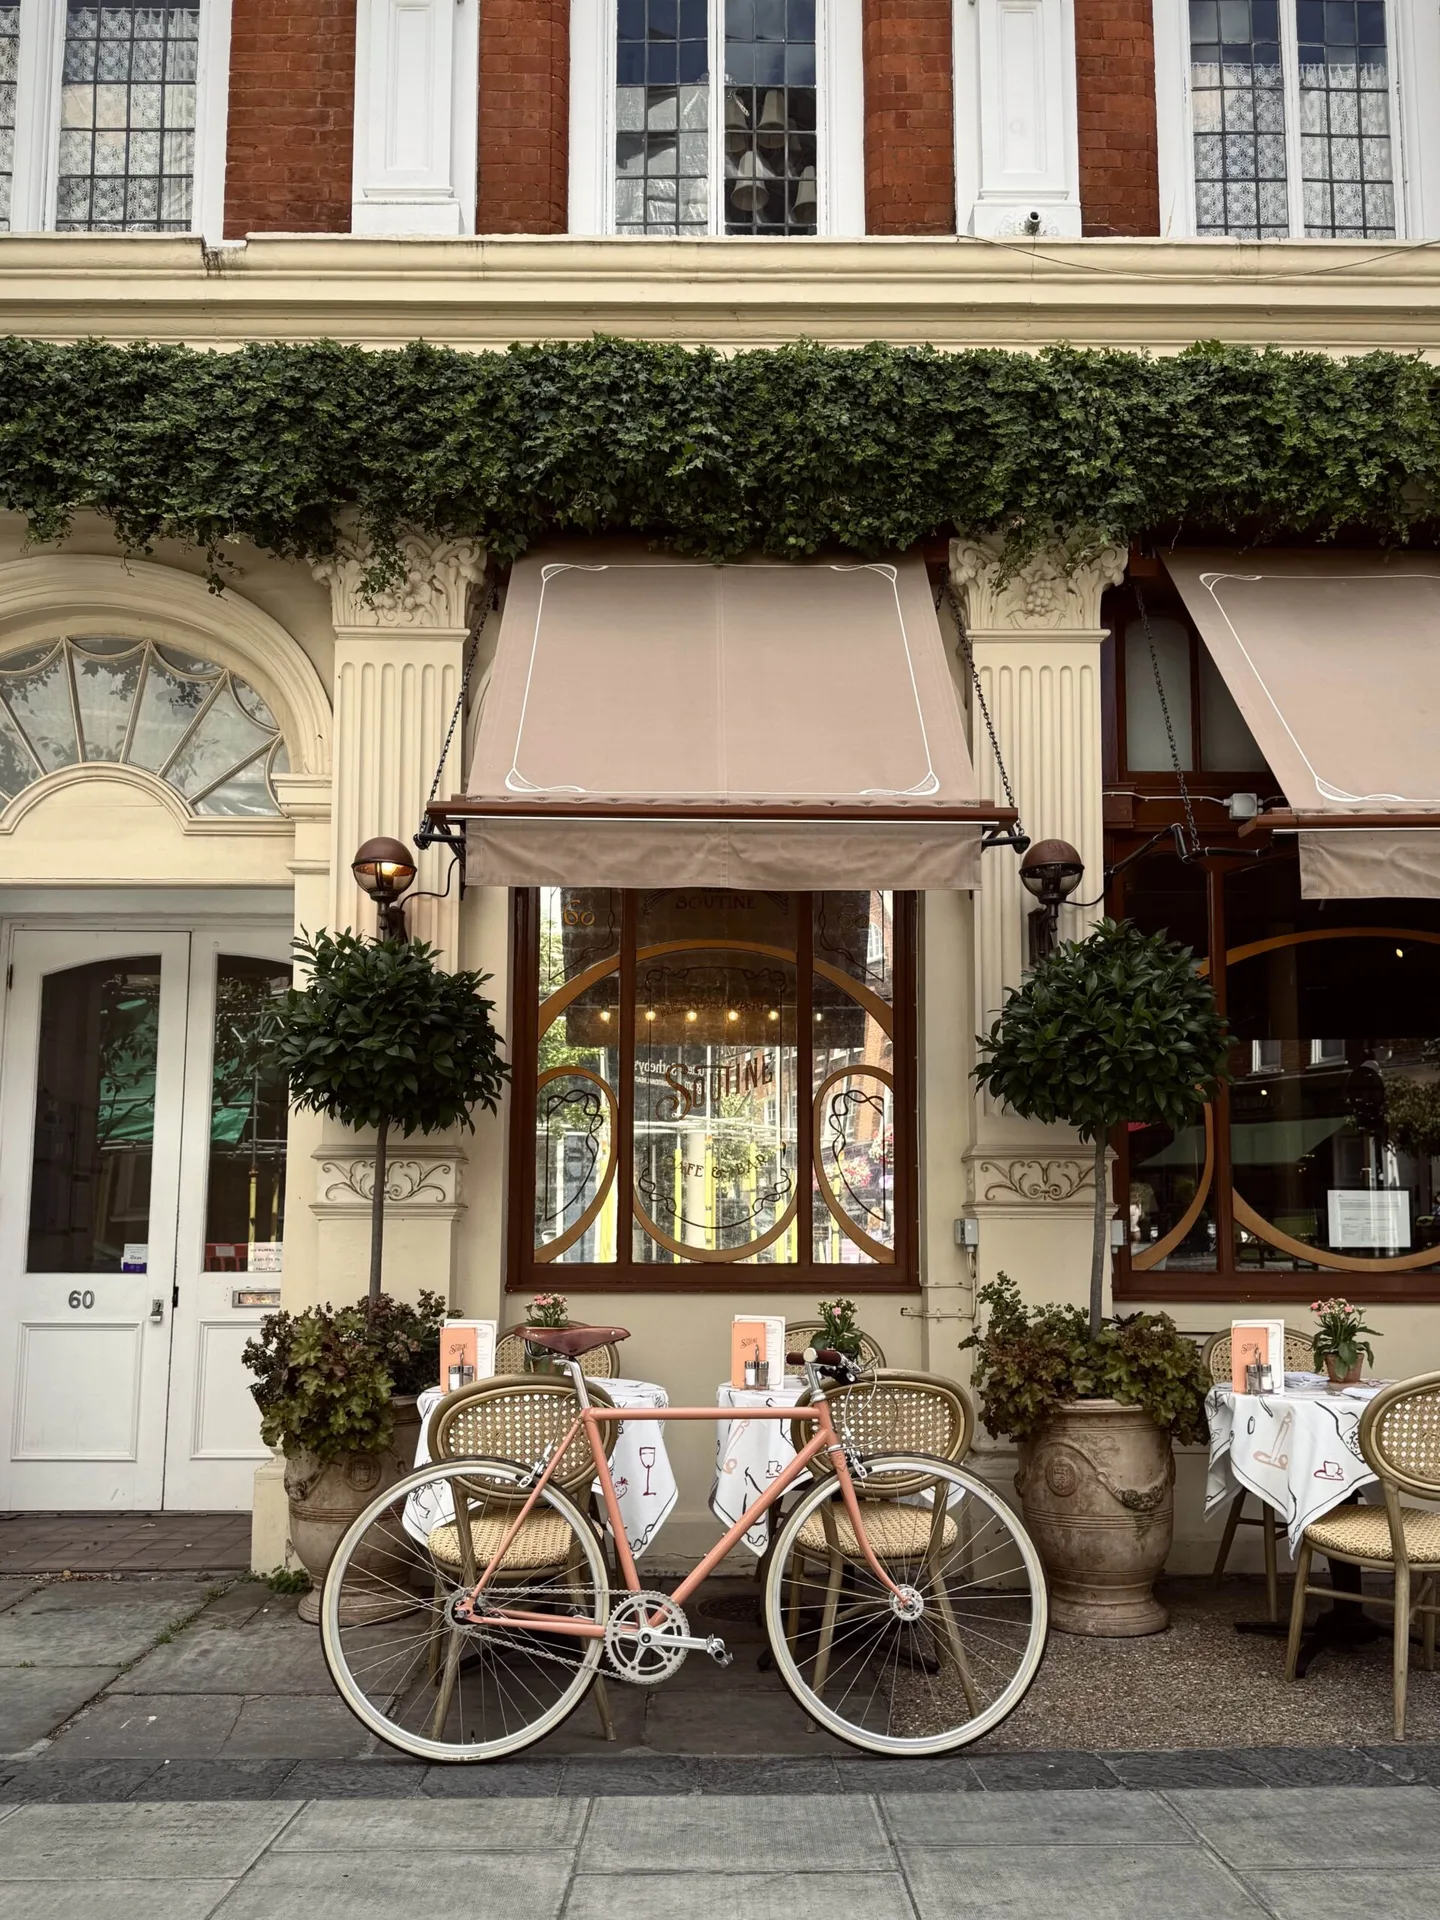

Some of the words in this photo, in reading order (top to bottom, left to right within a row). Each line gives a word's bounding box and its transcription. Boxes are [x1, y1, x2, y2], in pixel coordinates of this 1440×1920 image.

[563, 899, 596, 926] 60
[675, 894, 757, 910] SOUTINE
[655, 1051, 773, 1123] SOUTINE
[736, 1153, 769, 1176] BAR
[68, 1291, 95, 1309] 60
